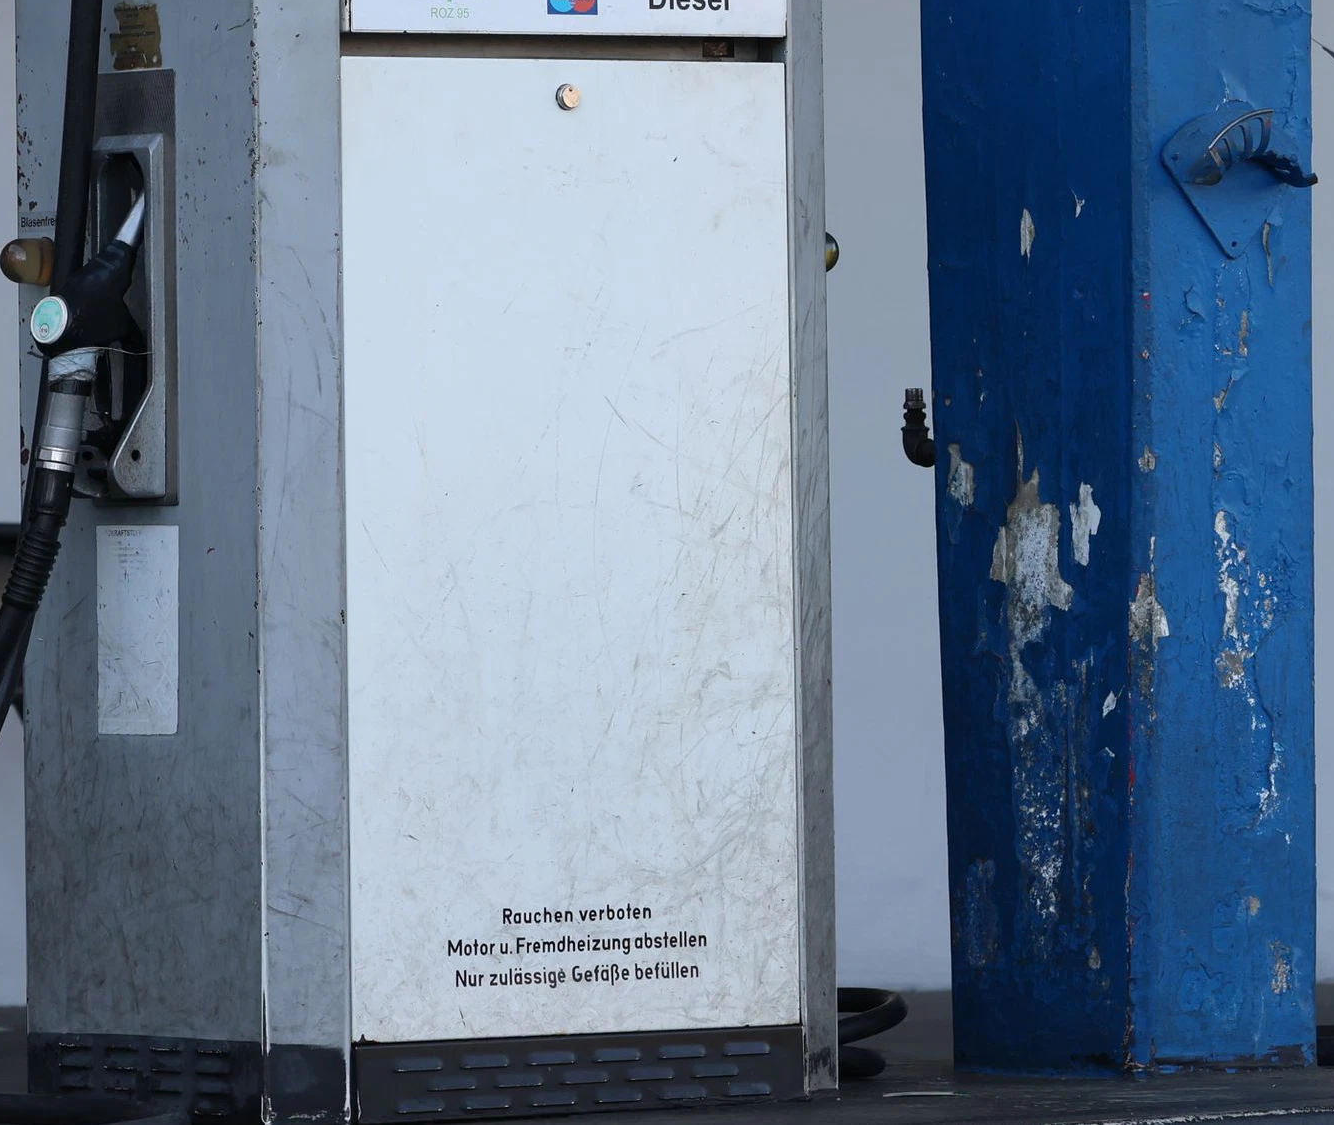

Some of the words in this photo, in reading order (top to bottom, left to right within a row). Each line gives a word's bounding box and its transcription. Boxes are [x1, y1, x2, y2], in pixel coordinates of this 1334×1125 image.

[431, 7, 454, 19] ROZ
[456, 7, 470, 19] 95
[503, 907, 573, 925] Rauchen
[579, 903, 652, 922] verboten
[447, 938, 495, 957] Motor
[500, 941, 513, 955] u.
[516, 935, 631, 955] Fremdheizung
[635, 931, 707, 949] abstellen
[455, 970, 484, 987] Nur
[489, 967, 566, 989] zulässige
[572, 965, 629, 985] Gefäße
[635, 963, 699, 980] befüllen
